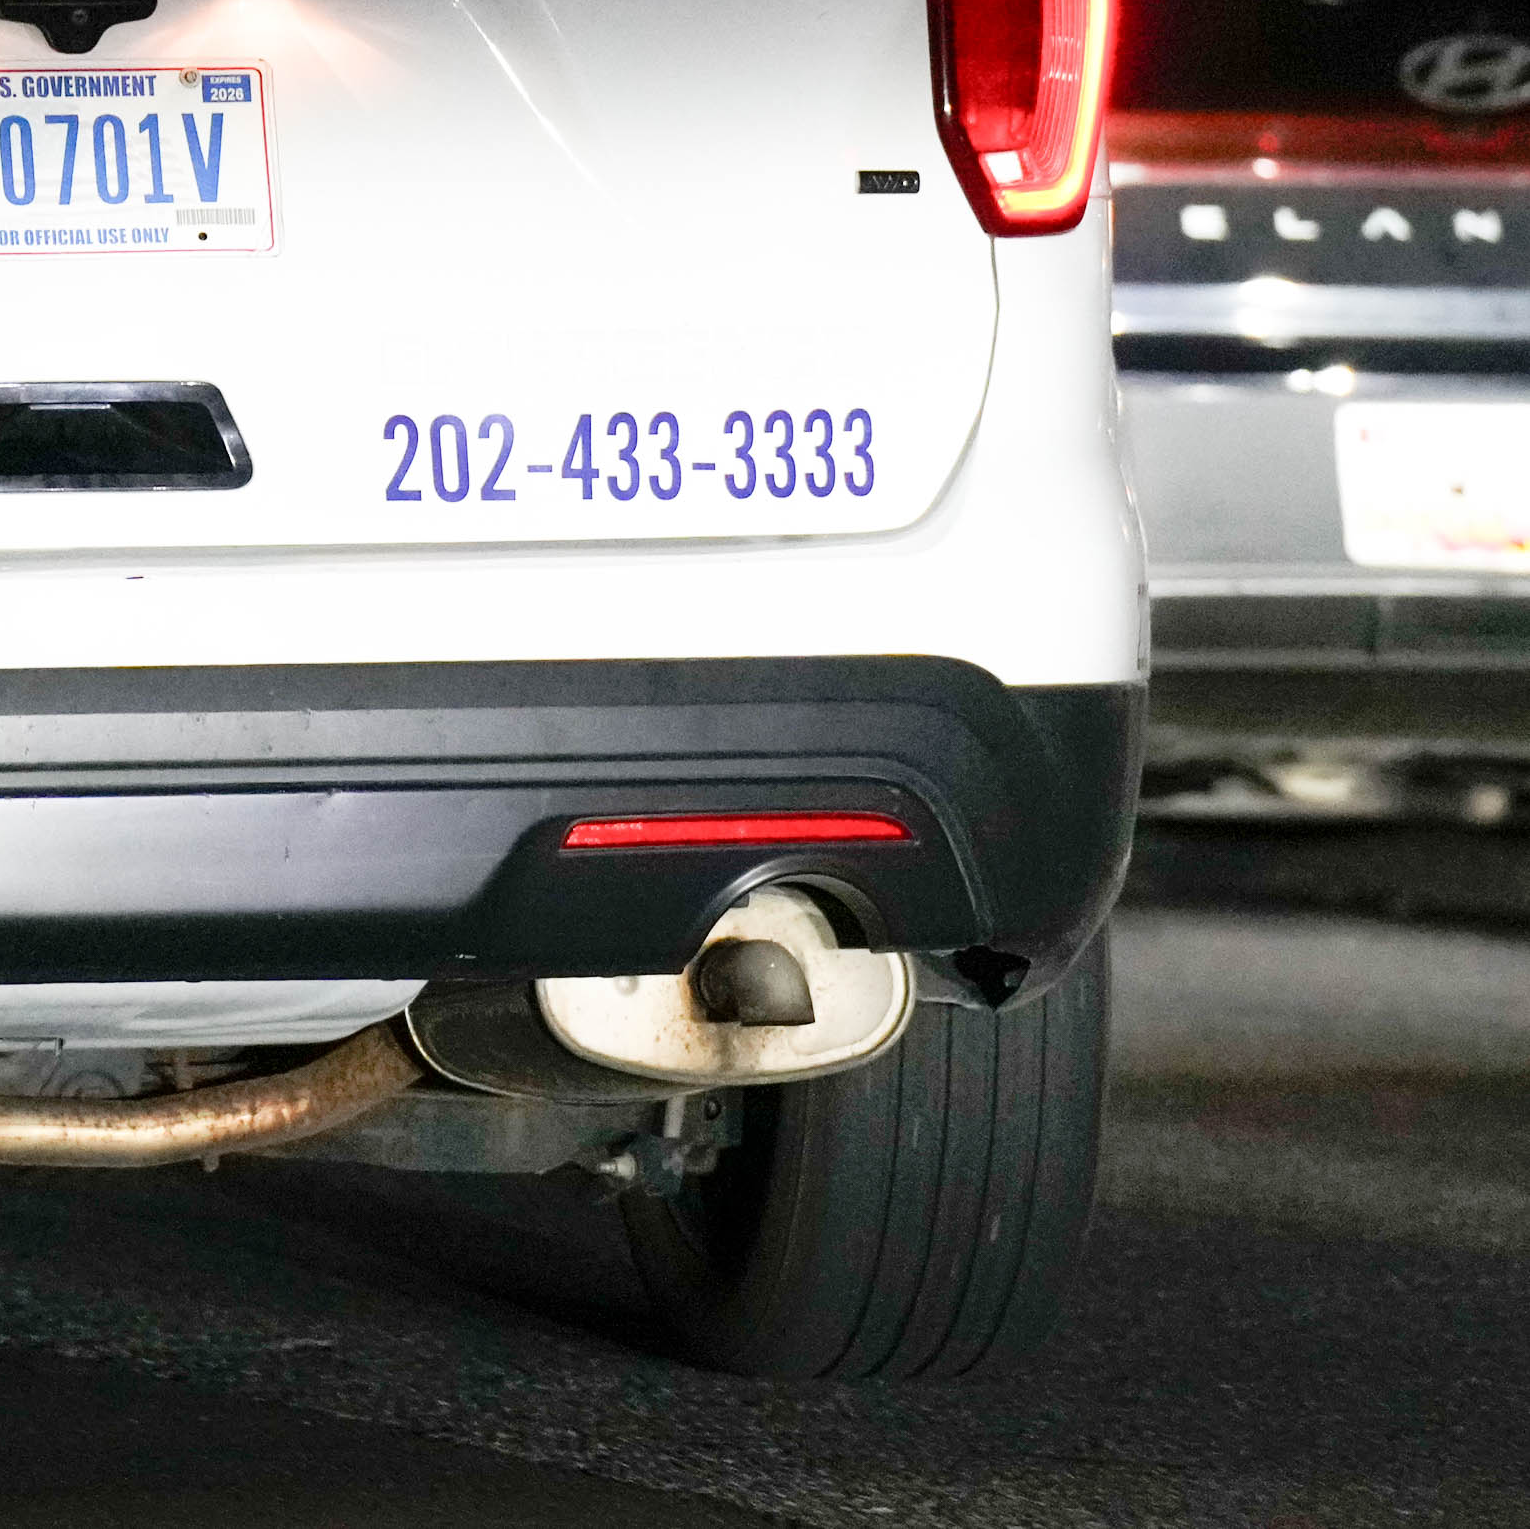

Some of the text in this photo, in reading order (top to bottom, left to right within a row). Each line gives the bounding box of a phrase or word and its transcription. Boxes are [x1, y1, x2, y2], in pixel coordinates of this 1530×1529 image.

[22, 74, 157, 98] GOVERNMENT
[210, 87, 244, 102] 2026
[0, 112, 224, 206] 0701V
[24, 228, 94, 246] OFFICIAL
[97, 227, 128, 245] USE
[131, 227, 169, 245] ONLY
[383, 408, 875, 502] 202-433-3333
